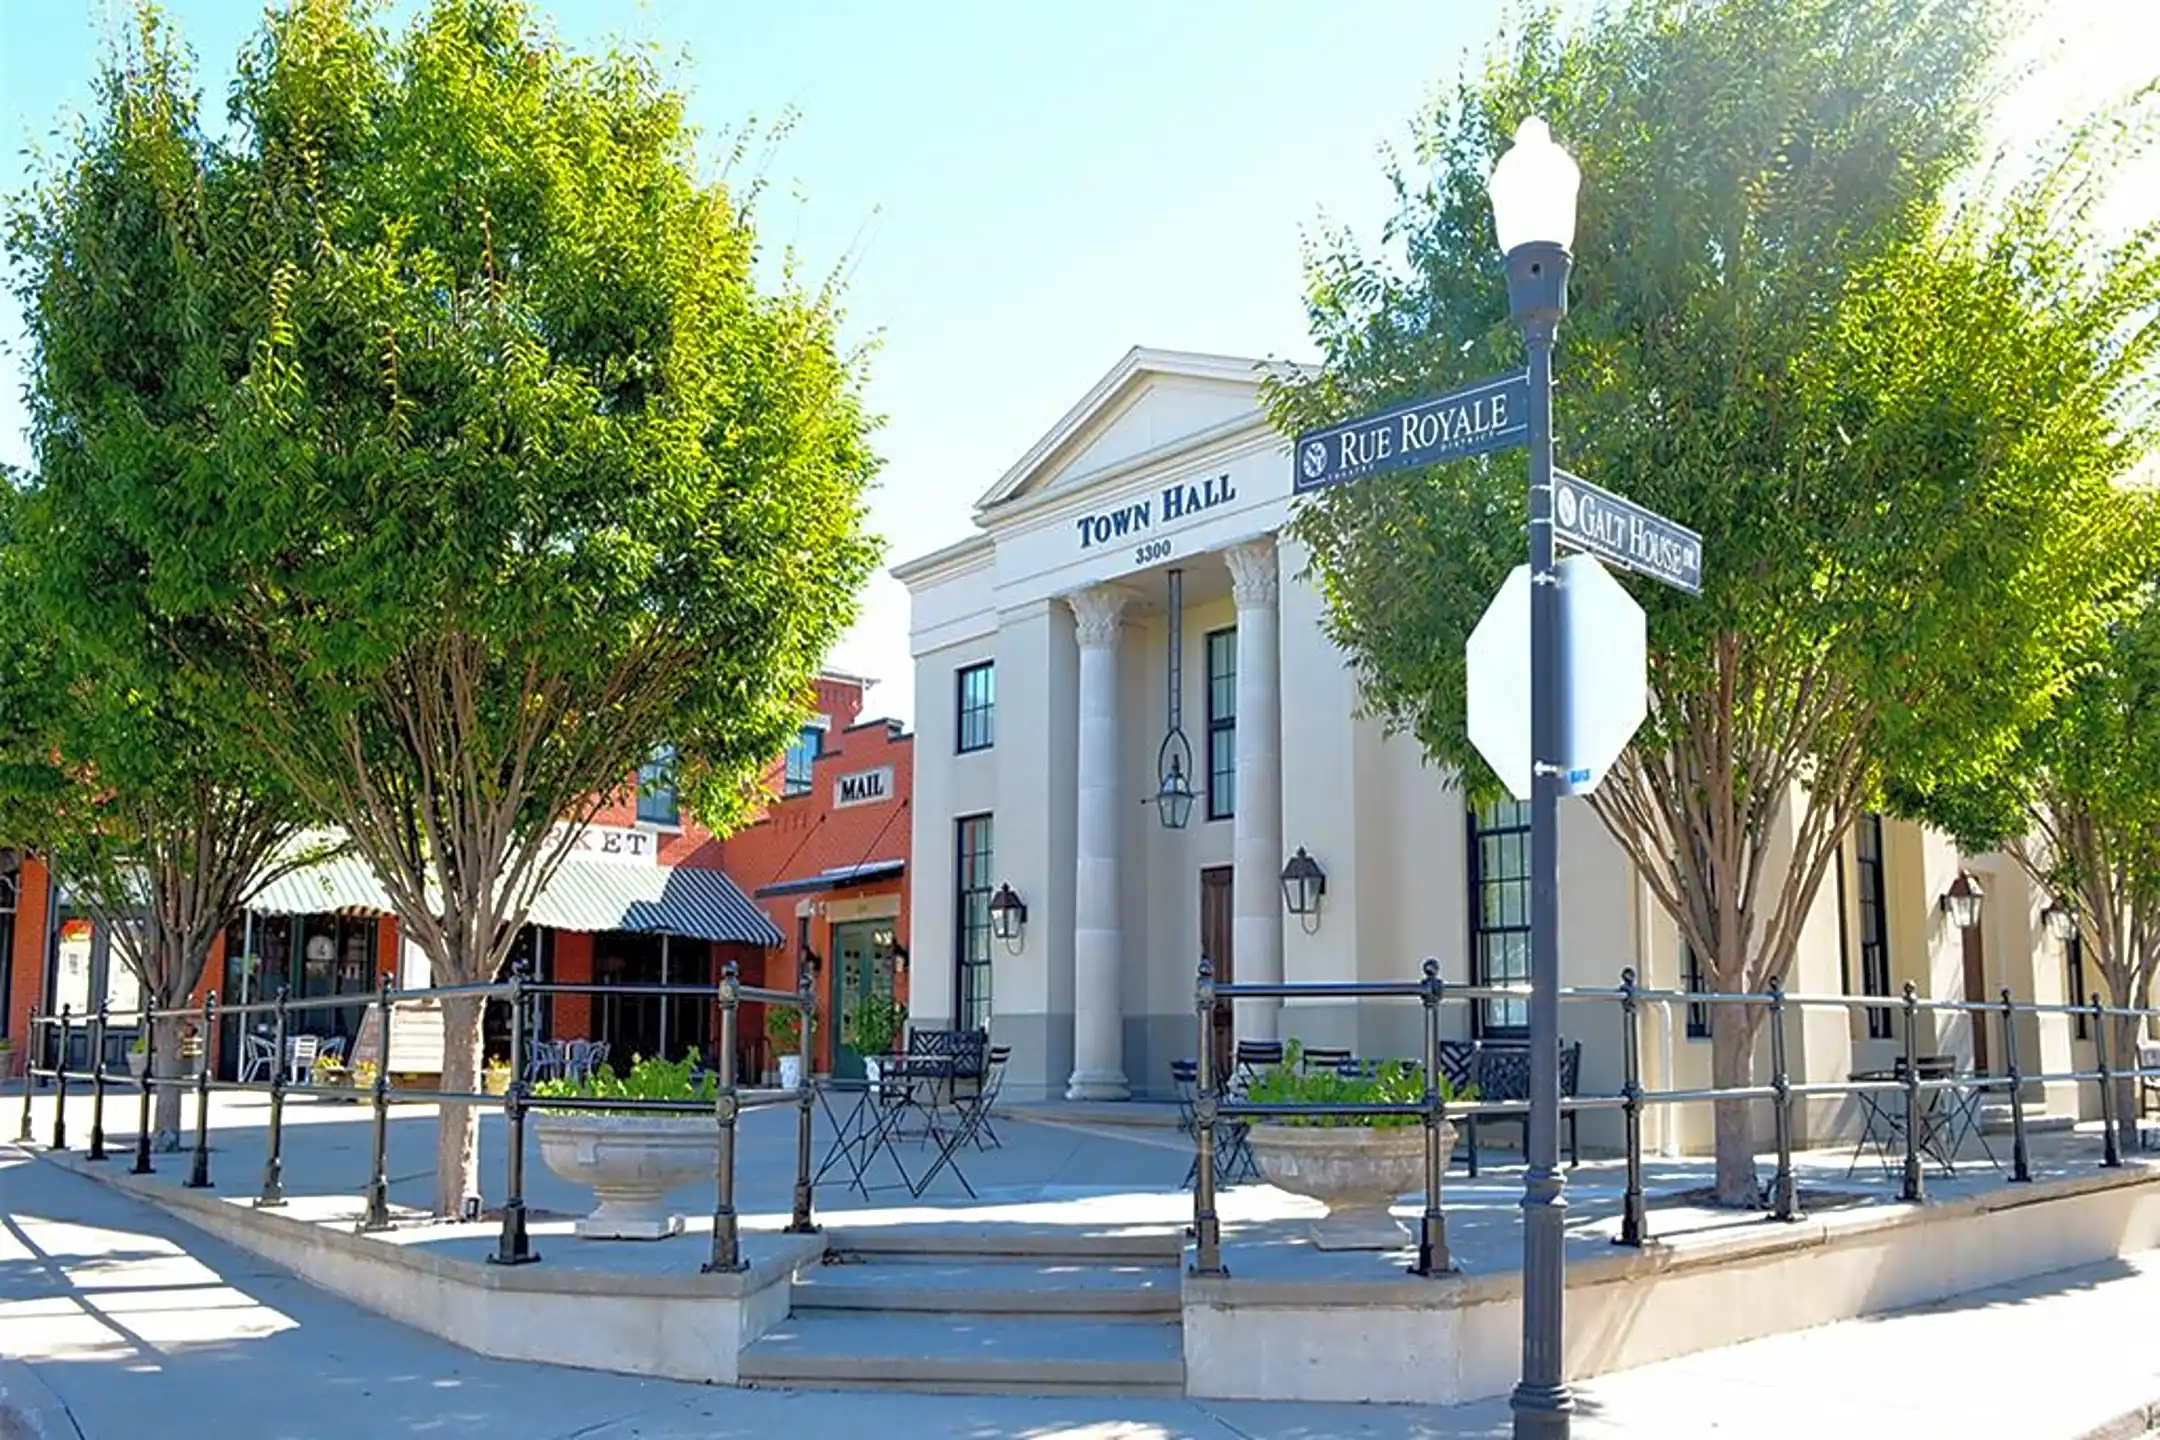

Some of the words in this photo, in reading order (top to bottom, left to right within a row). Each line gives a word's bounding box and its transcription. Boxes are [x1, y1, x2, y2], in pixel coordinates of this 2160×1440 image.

[1339, 428, 1392, 469] RUE
[1400, 394, 1508, 452] ROYALE
[1077, 501, 1151, 549] TOWN
[1161, 474, 1236, 522] HALL
[1580, 495, 1626, 548] GALT
[1629, 515, 1682, 575] HOUSE
[1135, 540, 1171, 565] 3300
[840, 772, 884, 803] MAIL
